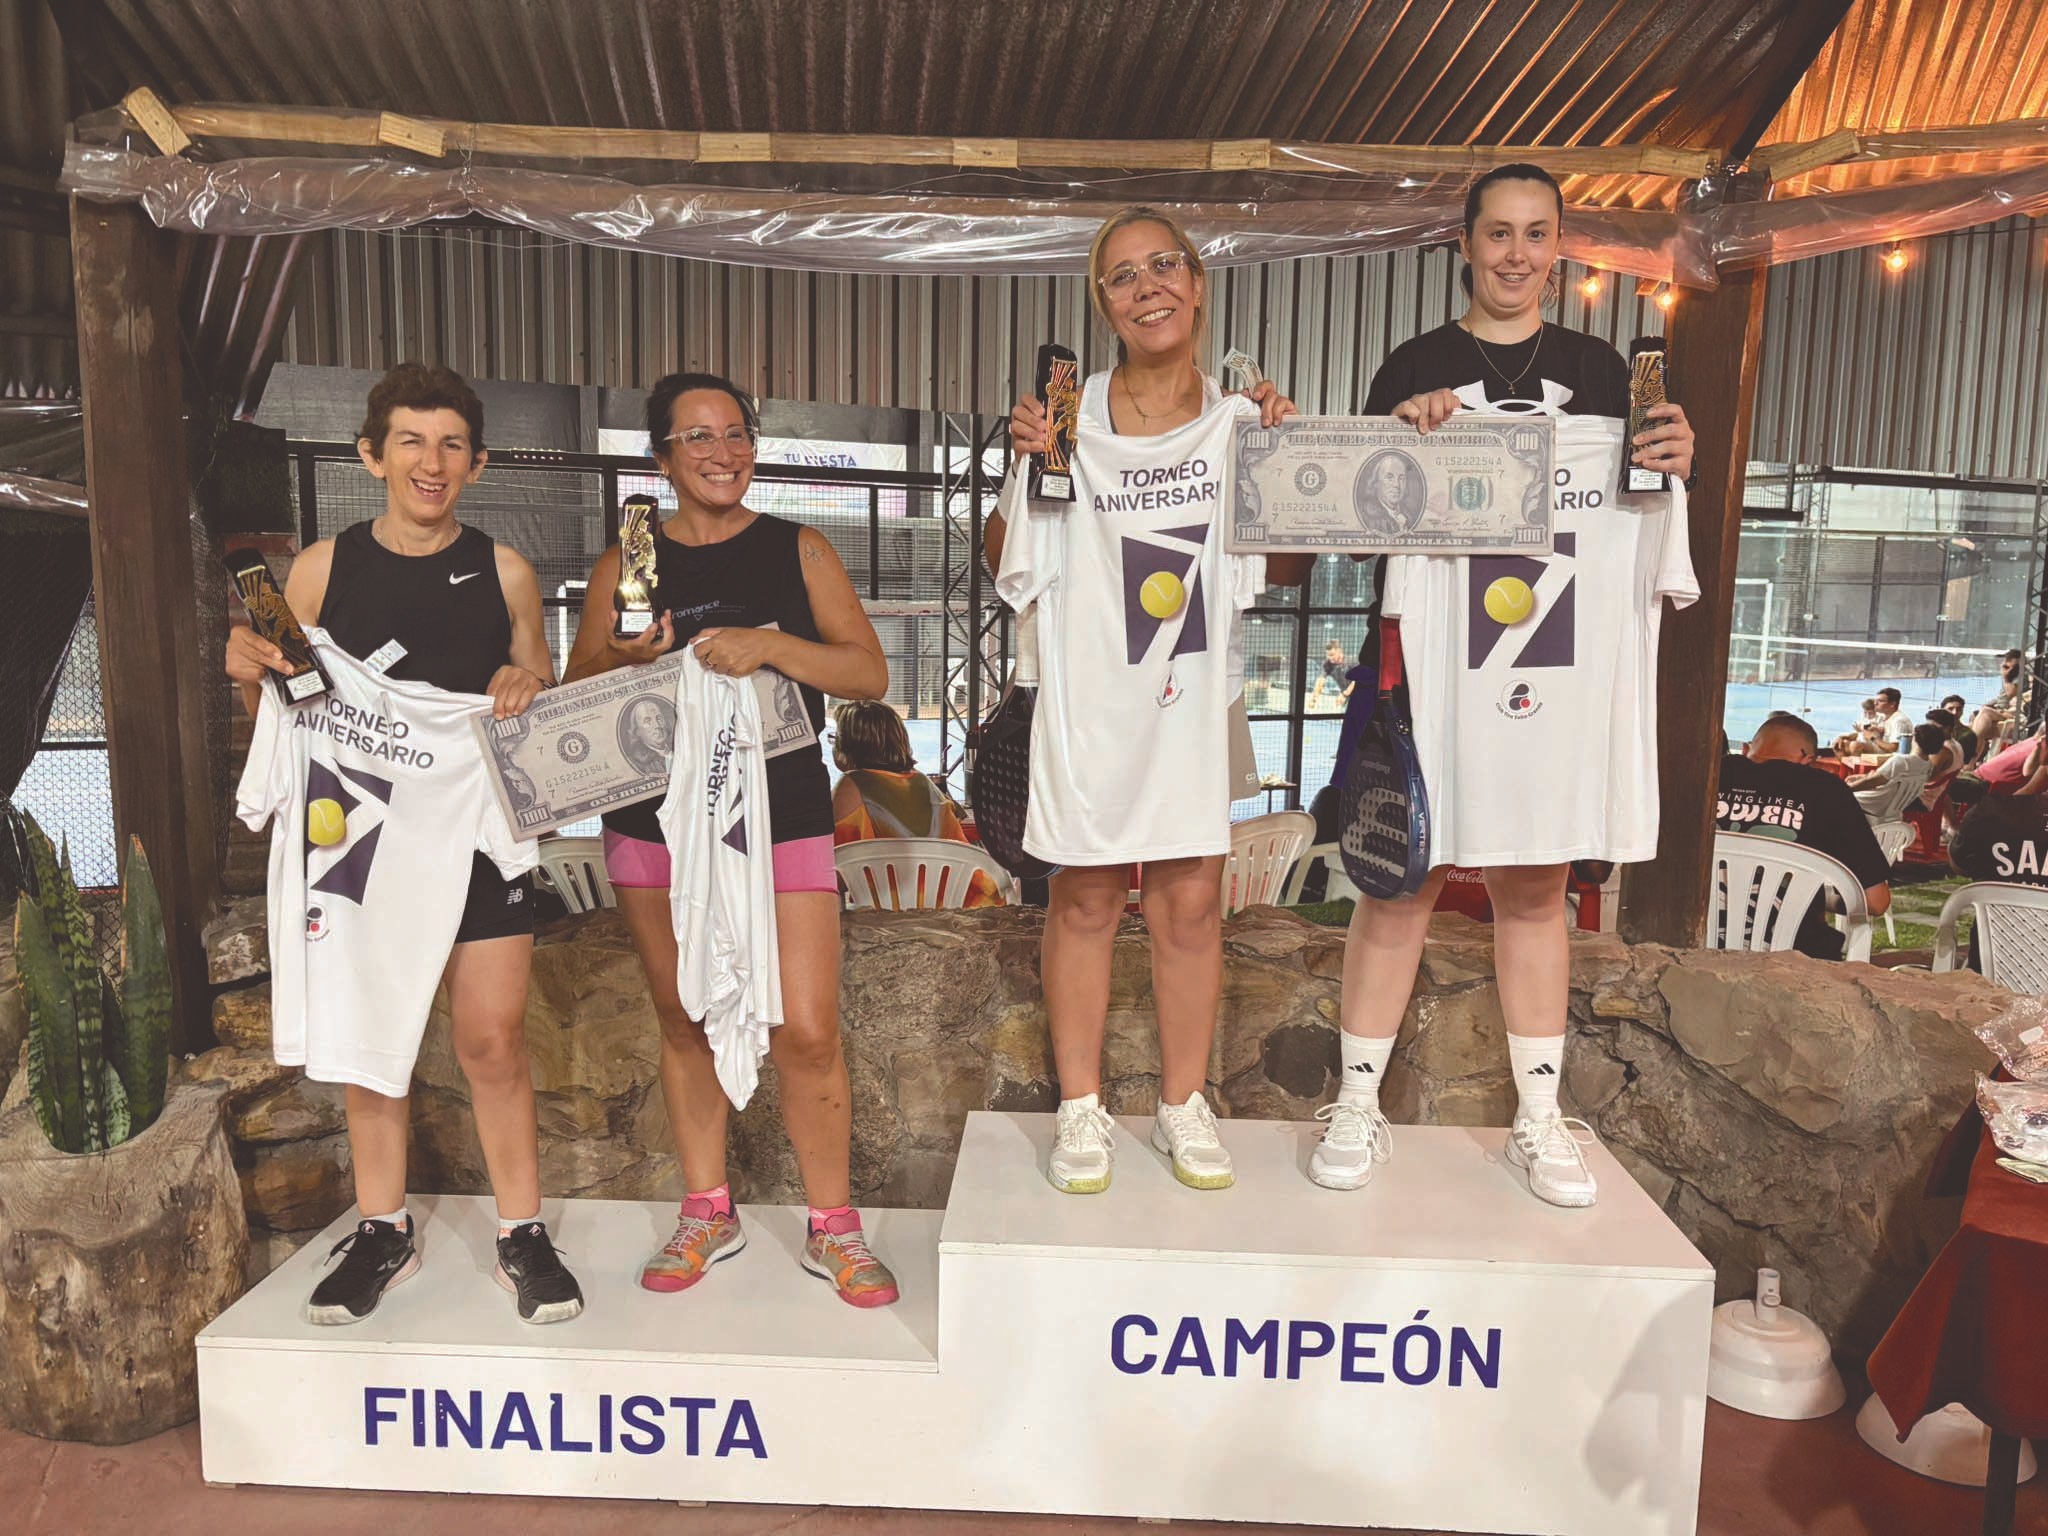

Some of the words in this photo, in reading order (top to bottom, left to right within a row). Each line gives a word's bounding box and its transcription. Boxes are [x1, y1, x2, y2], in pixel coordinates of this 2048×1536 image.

[1246, 431, 1270, 448] 100
[1286, 434, 1314, 446] THE
[1316, 434, 1364, 446] UNITED
[1366, 434, 1417, 446] STATES
[1419, 434, 1437, 447] OF
[1439, 435, 1503, 447] AMERICA
[1515, 432, 1539, 450] 100
[784, 453, 800, 463] TU
[1120, 459, 1208, 488] TORNEO
[1094, 480, 1220, 512] ANIVERSARI
[1241, 526, 1264, 540] 100
[1305, 537, 1334, 545] ONE
[1336, 537, 1406, 545] HUNDRED
[1408, 537, 1472, 545] DOLLARS
[1518, 528, 1543, 542] 100
[566, 691, 614, 715] UNITED
[614, 675, 662, 700] STATES
[324, 693, 409, 739] TORNEO
[494, 717, 522, 739] 100
[780, 725, 803, 742] 100
[294, 710, 434, 769] ANIVERSARIO
[567, 740, 580, 755] G
[590, 793, 619, 808] ONE
[619, 777, 669, 801] HUNDR
[524, 808, 550, 827] 100
[1418, 812, 1426, 855] VERTEX
[1110, 1309, 1502, 1389] CAMPEÓN
[364, 1387, 768, 1459] FINALISTA
